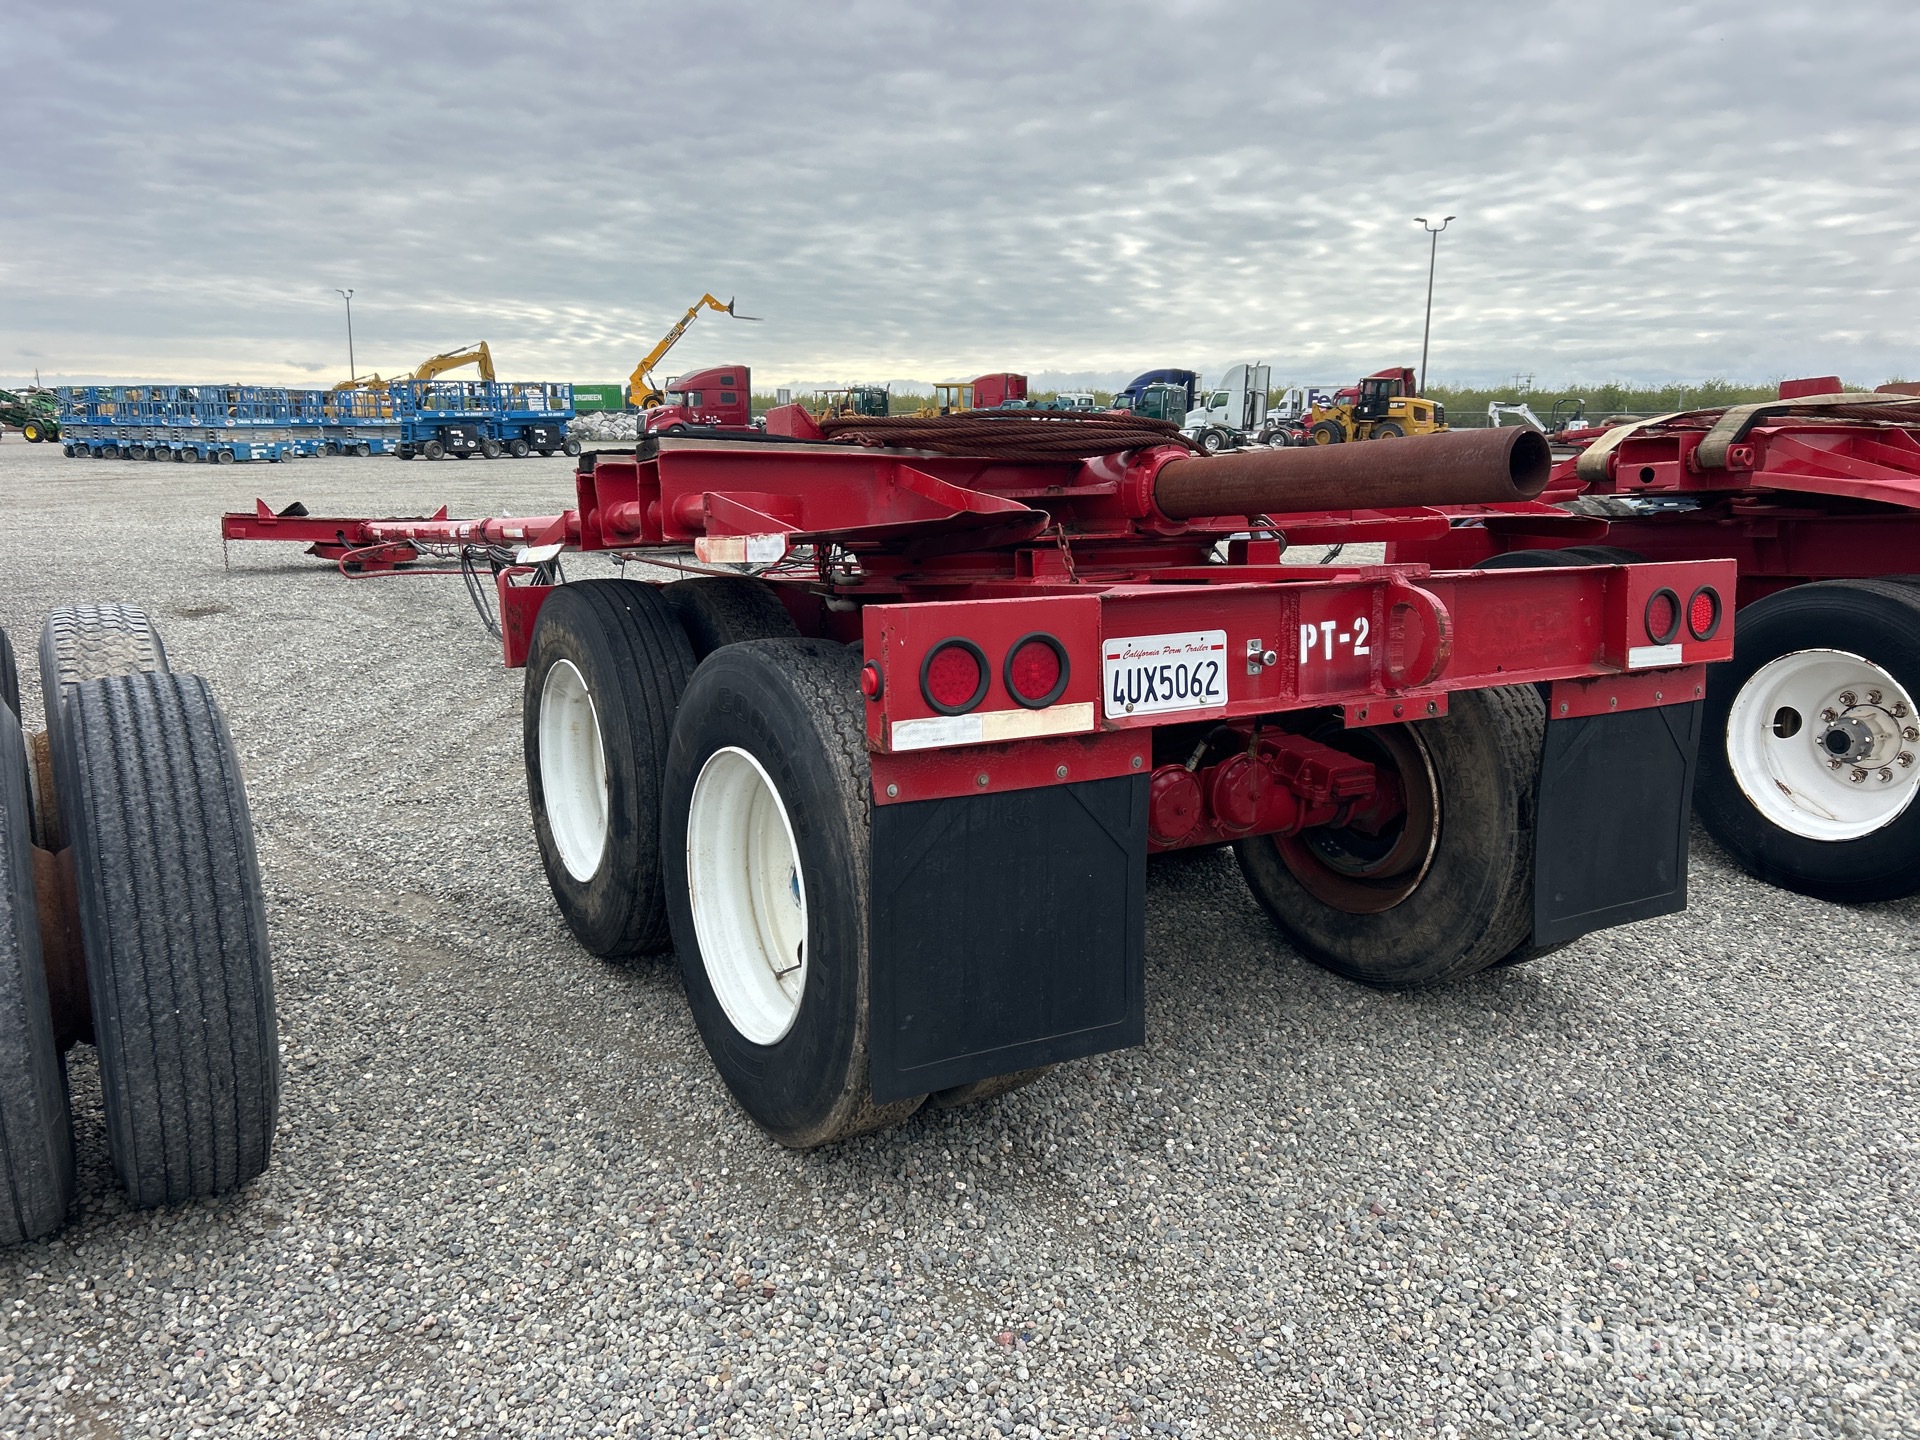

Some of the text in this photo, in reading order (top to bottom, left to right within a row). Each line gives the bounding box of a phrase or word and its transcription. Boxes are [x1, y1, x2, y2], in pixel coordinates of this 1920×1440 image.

[665, 326, 679, 342] JCB
[1123, 643, 1209, 660] California Perm Trailer
[1300, 617, 1370, 664] PT-2
[1113, 661, 1219, 705] 4UX5062
[718, 687, 812, 839] COOPER
